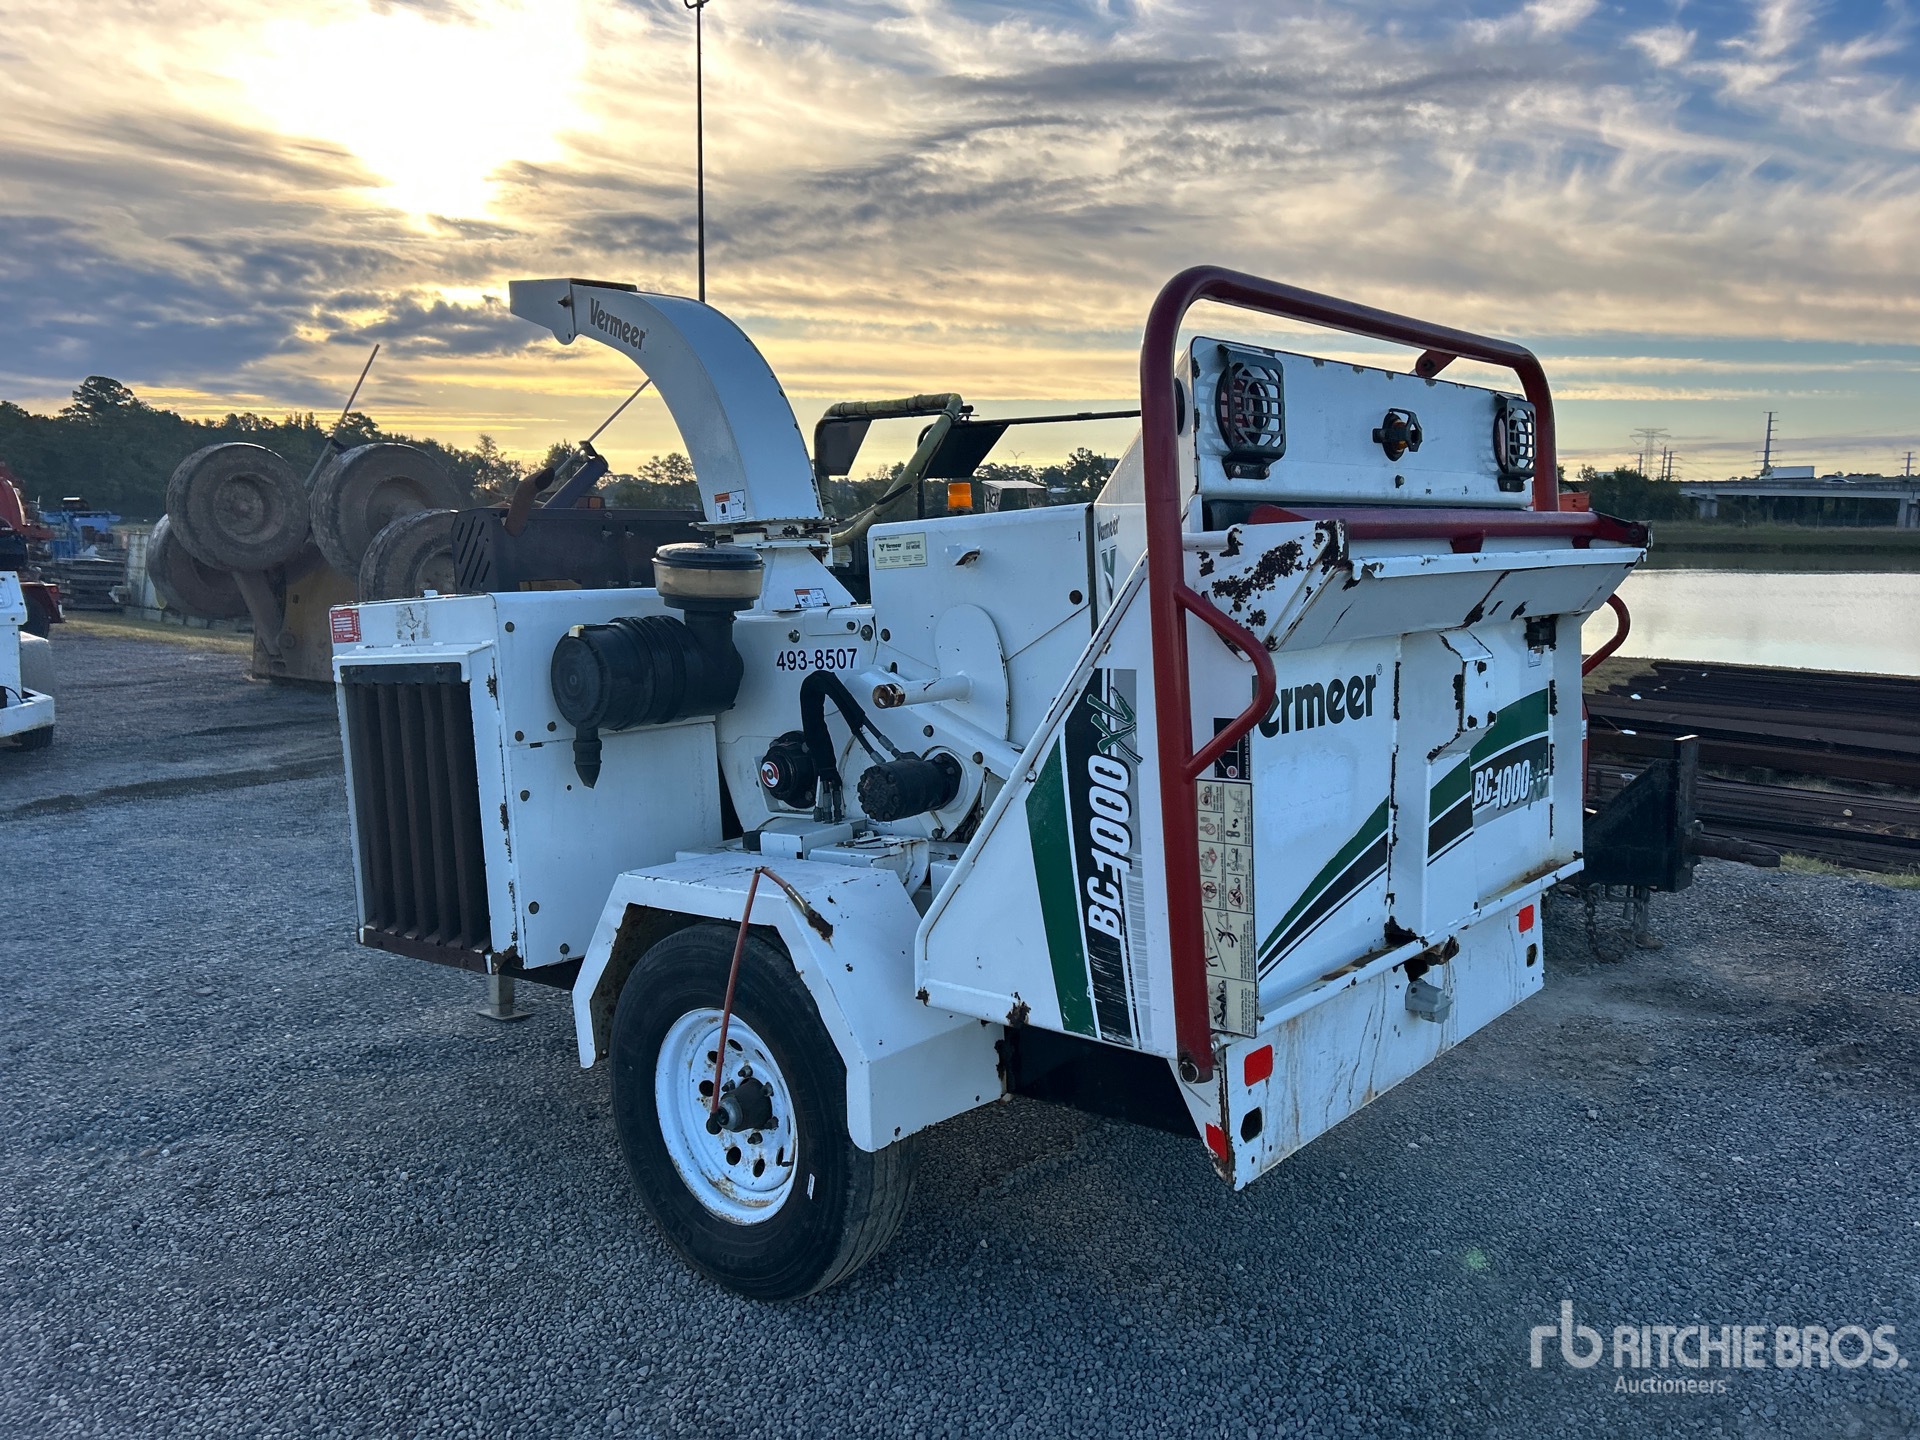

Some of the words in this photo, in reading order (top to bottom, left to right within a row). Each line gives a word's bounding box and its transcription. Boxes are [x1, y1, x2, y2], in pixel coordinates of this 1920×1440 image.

[589, 297, 646, 350] Vermeer
[776, 648, 858, 671] 493-8507
[1086, 686, 1144, 766] XL
[1252, 673, 1377, 739] ermeer
